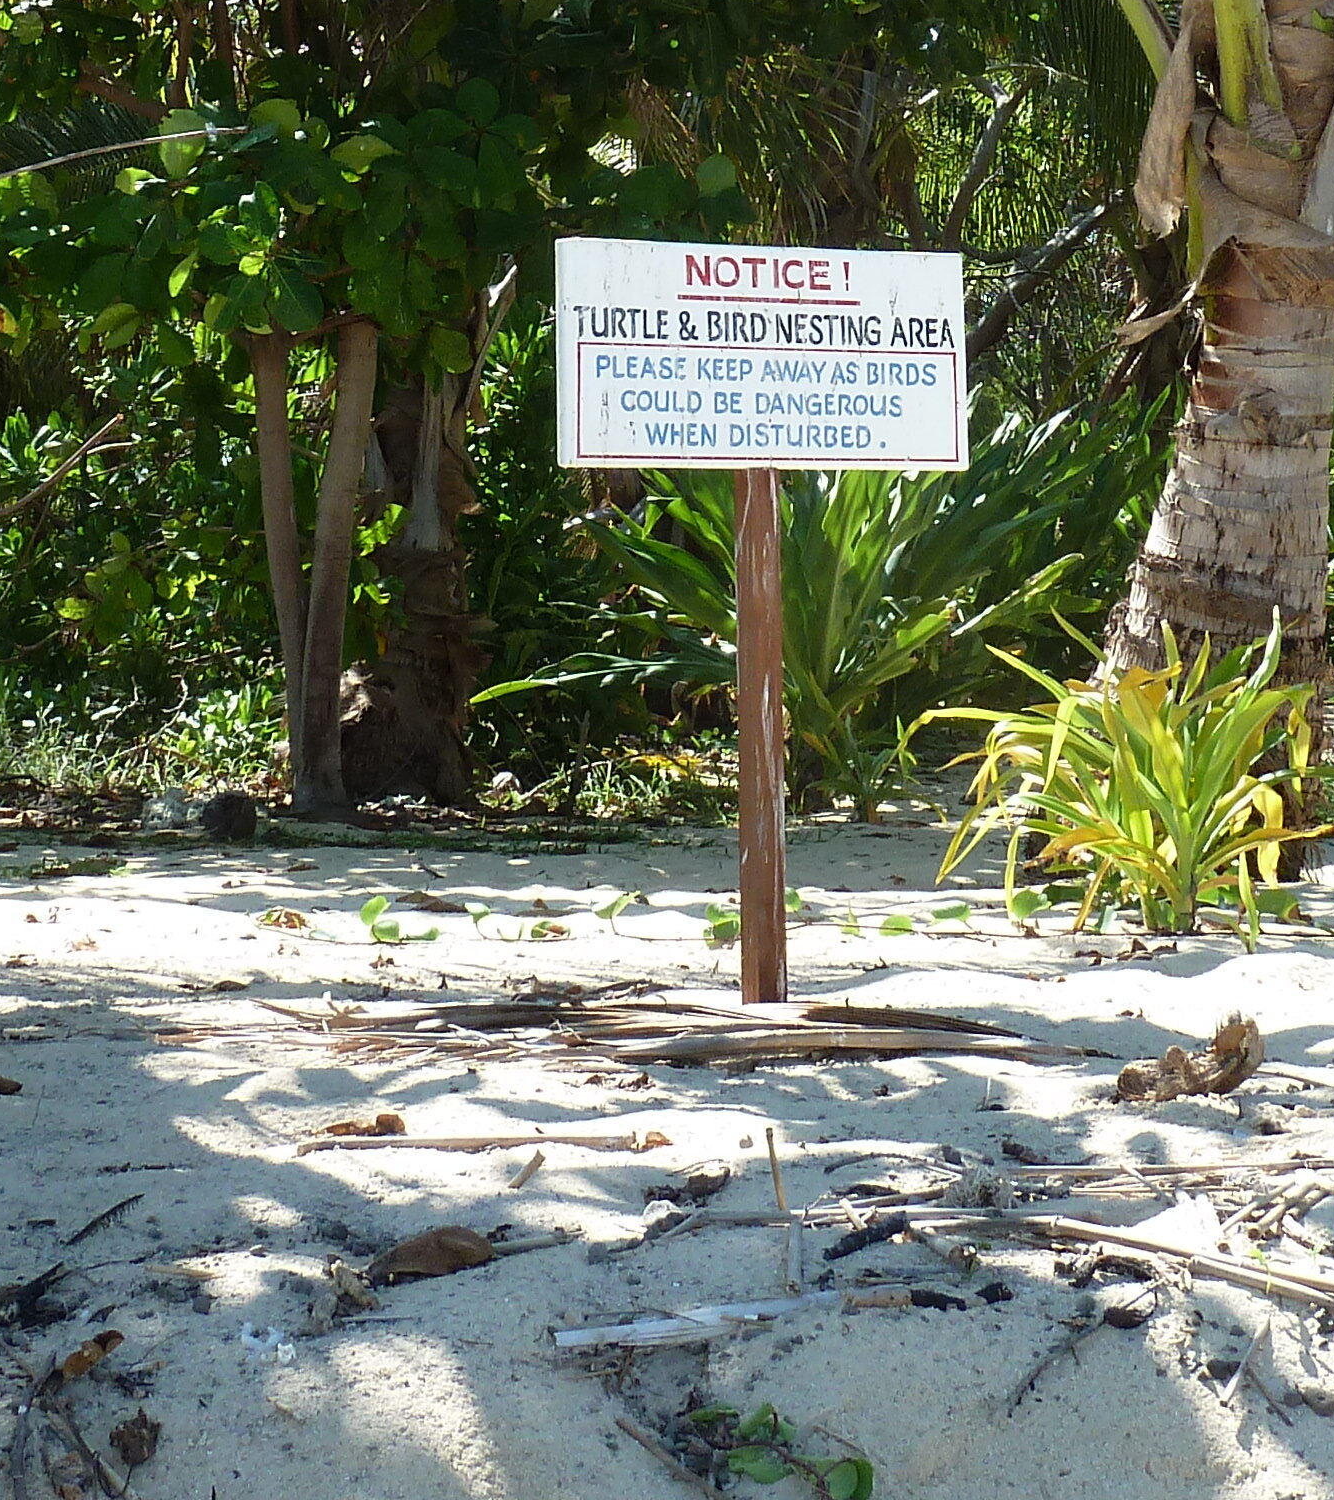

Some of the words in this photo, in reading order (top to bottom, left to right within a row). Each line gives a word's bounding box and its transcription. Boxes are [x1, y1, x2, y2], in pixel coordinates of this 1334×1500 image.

[574, 306, 669, 340] TURTLE
[679, 315, 699, 340] &
[708, 311, 767, 343] BIRD
[776, 313, 881, 346] NESTING
[890, 318, 955, 348] AREA
[596, 355, 686, 380] PLEASE
[697, 358, 753, 382] KEEP
[761, 360, 827, 384] AWAY
[831, 362, 860, 385] AS
[867, 363, 937, 386] BIRDS
[620, 390, 702, 413] COULD
[714, 391, 743, 414] BE
[755, 393, 903, 417] DANGEROUS
[646, 424, 716, 447] WHEN
